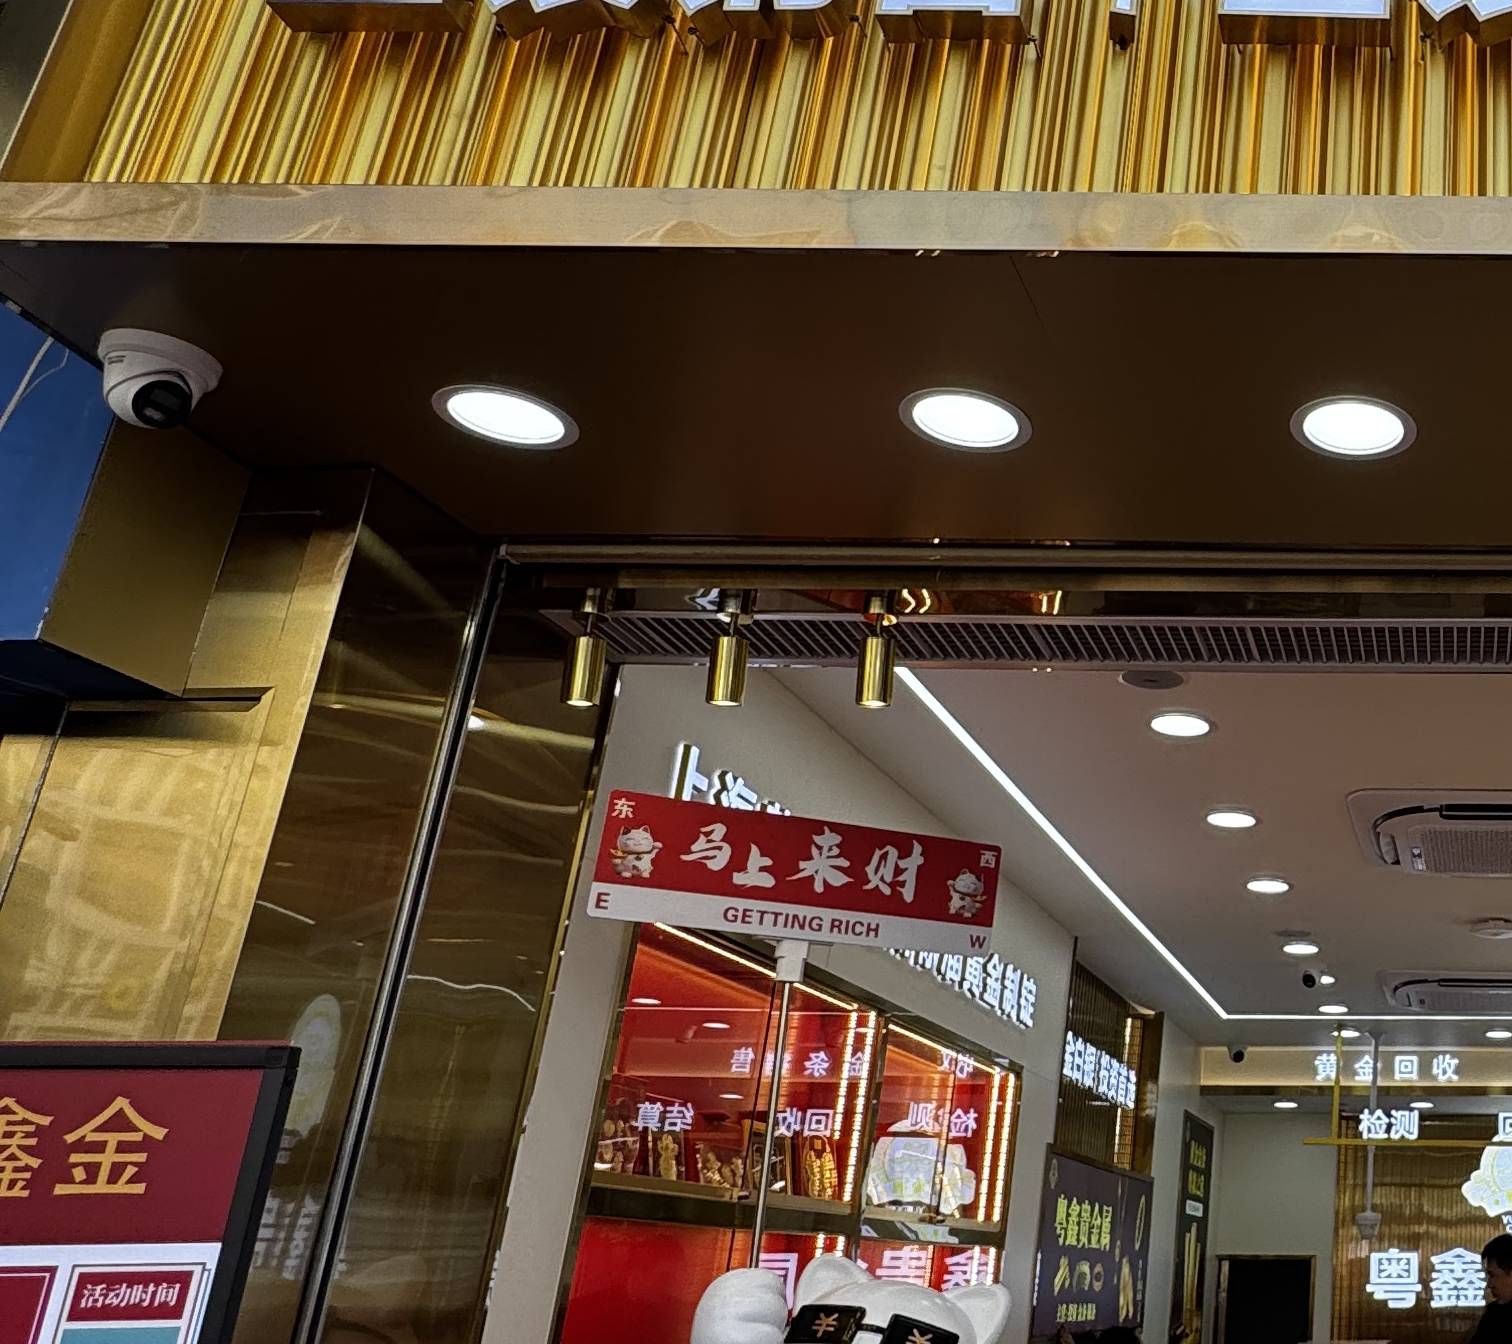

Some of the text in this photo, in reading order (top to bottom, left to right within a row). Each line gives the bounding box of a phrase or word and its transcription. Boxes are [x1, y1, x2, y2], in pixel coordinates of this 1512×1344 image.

[610, 797, 636, 819] 东
[680, 822, 925, 904] 马上来财
[979, 850, 998, 869] 西
[594, 891, 611, 911] E
[722, 906, 880, 938] GETTING RICH
[969, 934, 987, 950] W
[1314, 1053, 1460, 1083] 黄金回收
[1358, 1109, 1420, 1140] 检测
[79, 1282, 181, 1309] 活动时间
